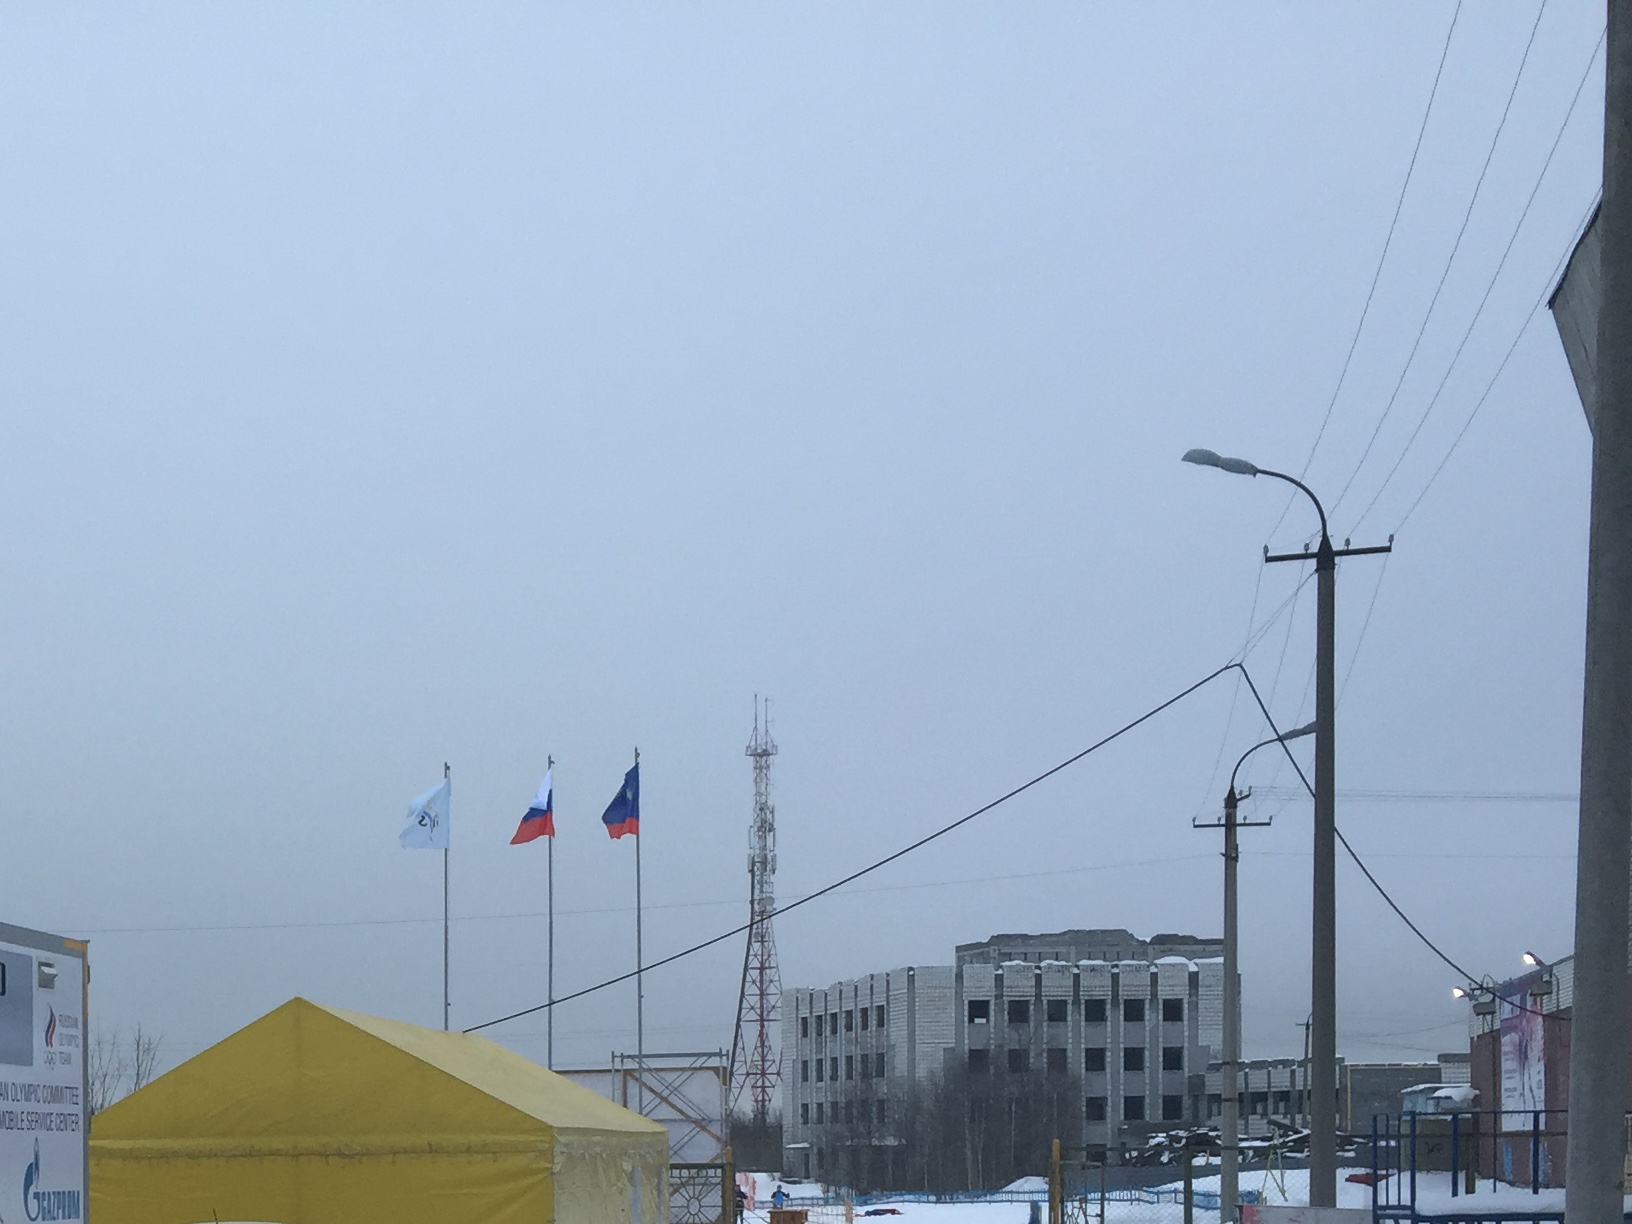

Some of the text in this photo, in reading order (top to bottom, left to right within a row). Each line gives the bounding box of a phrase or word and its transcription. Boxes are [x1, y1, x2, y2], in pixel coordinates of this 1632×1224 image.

[10, 1082, 41, 1104] OLYMPIC
[42, 1084, 79, 1106] COMMITTEE
[26, 1111, 54, 1132] SERVICE
[55, 1112, 79, 1132] CENTER
